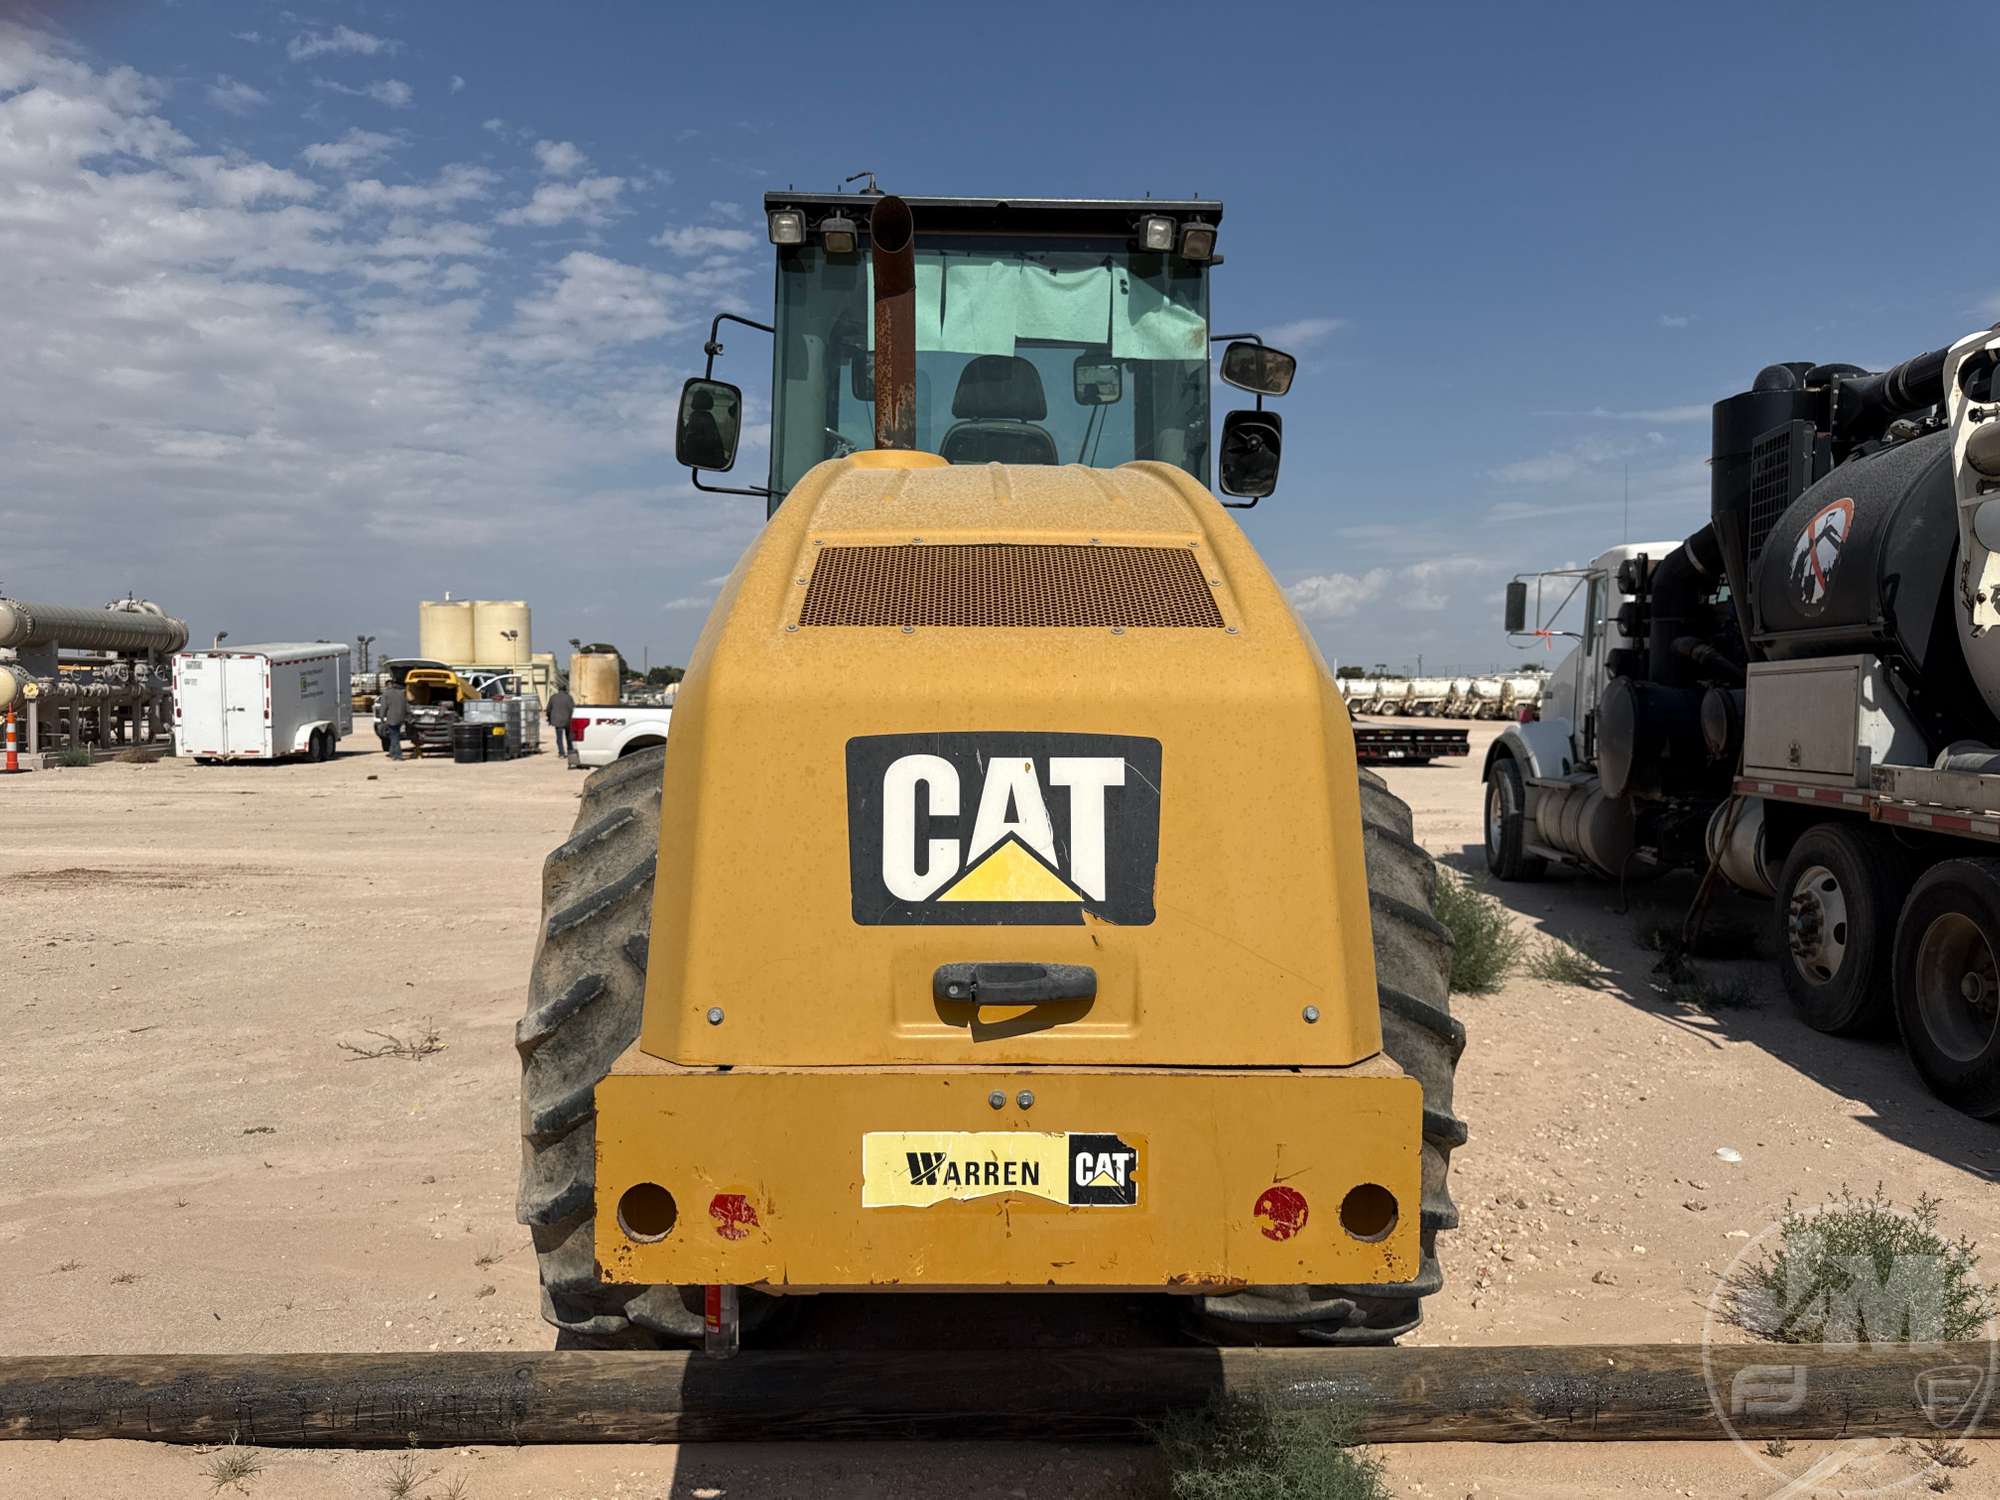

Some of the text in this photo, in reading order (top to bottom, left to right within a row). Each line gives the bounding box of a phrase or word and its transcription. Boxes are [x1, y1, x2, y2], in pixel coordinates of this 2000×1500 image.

[596, 718, 626, 726] FX4
[882, 753, 1125, 902] CAT
[906, 1151, 1040, 1186] WARREN
